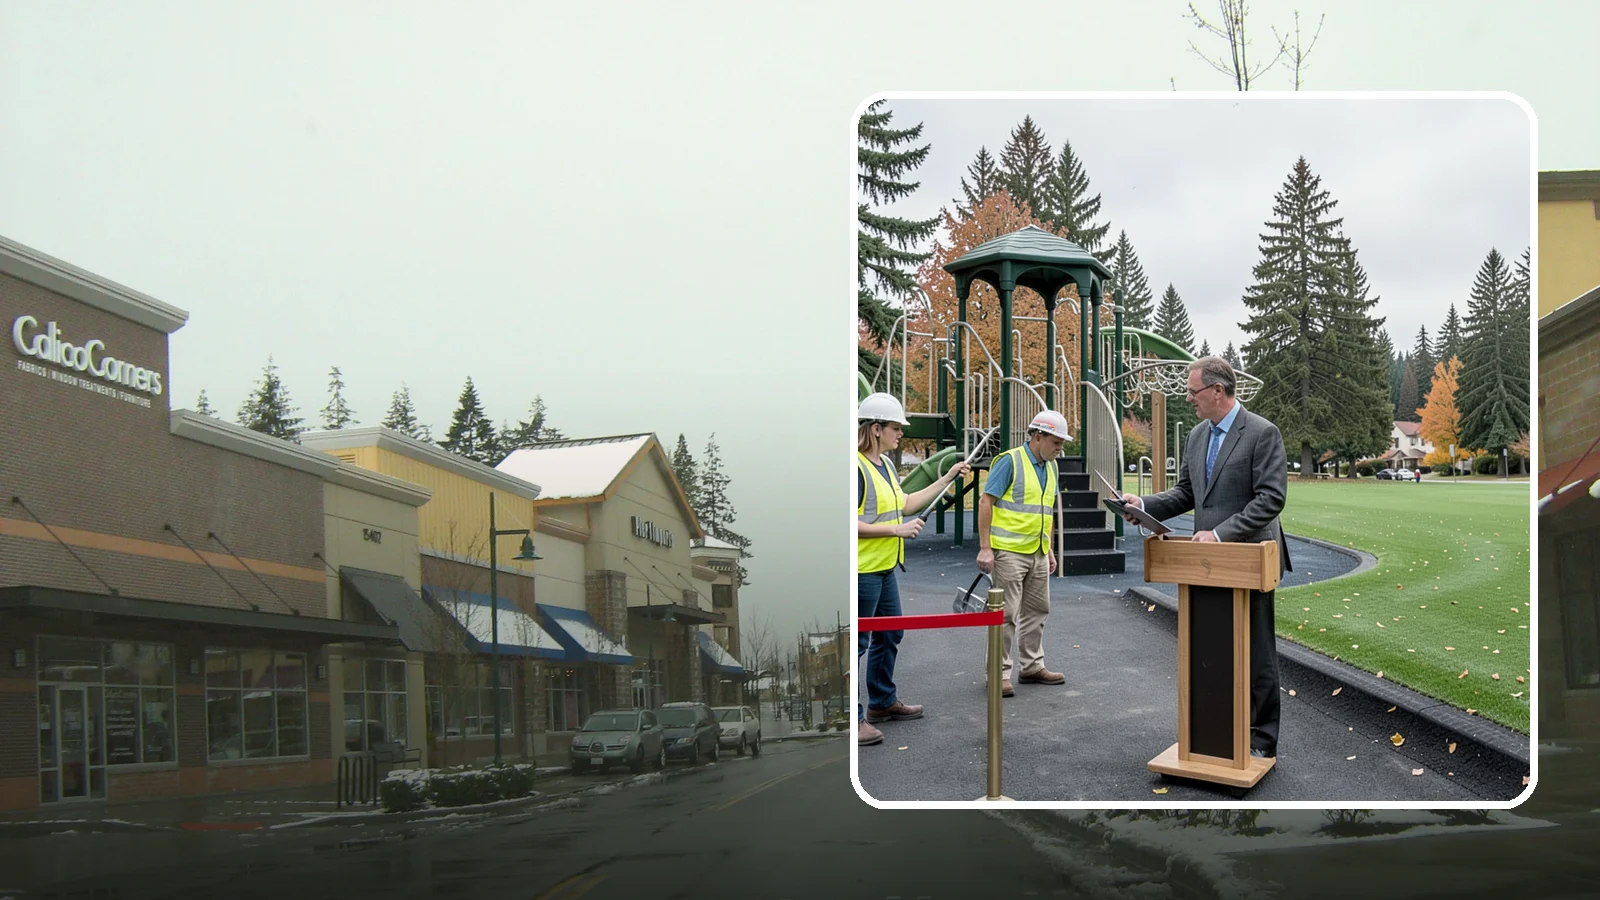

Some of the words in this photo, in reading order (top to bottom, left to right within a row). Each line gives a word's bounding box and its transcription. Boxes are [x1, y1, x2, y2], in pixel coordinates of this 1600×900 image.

[17, 360, 47, 376] FABRICS
[51, 371, 78, 386] WINDOW
[78, 378, 117, 398] TREATMENTS
[120, 391, 151, 408] FURNITURE
